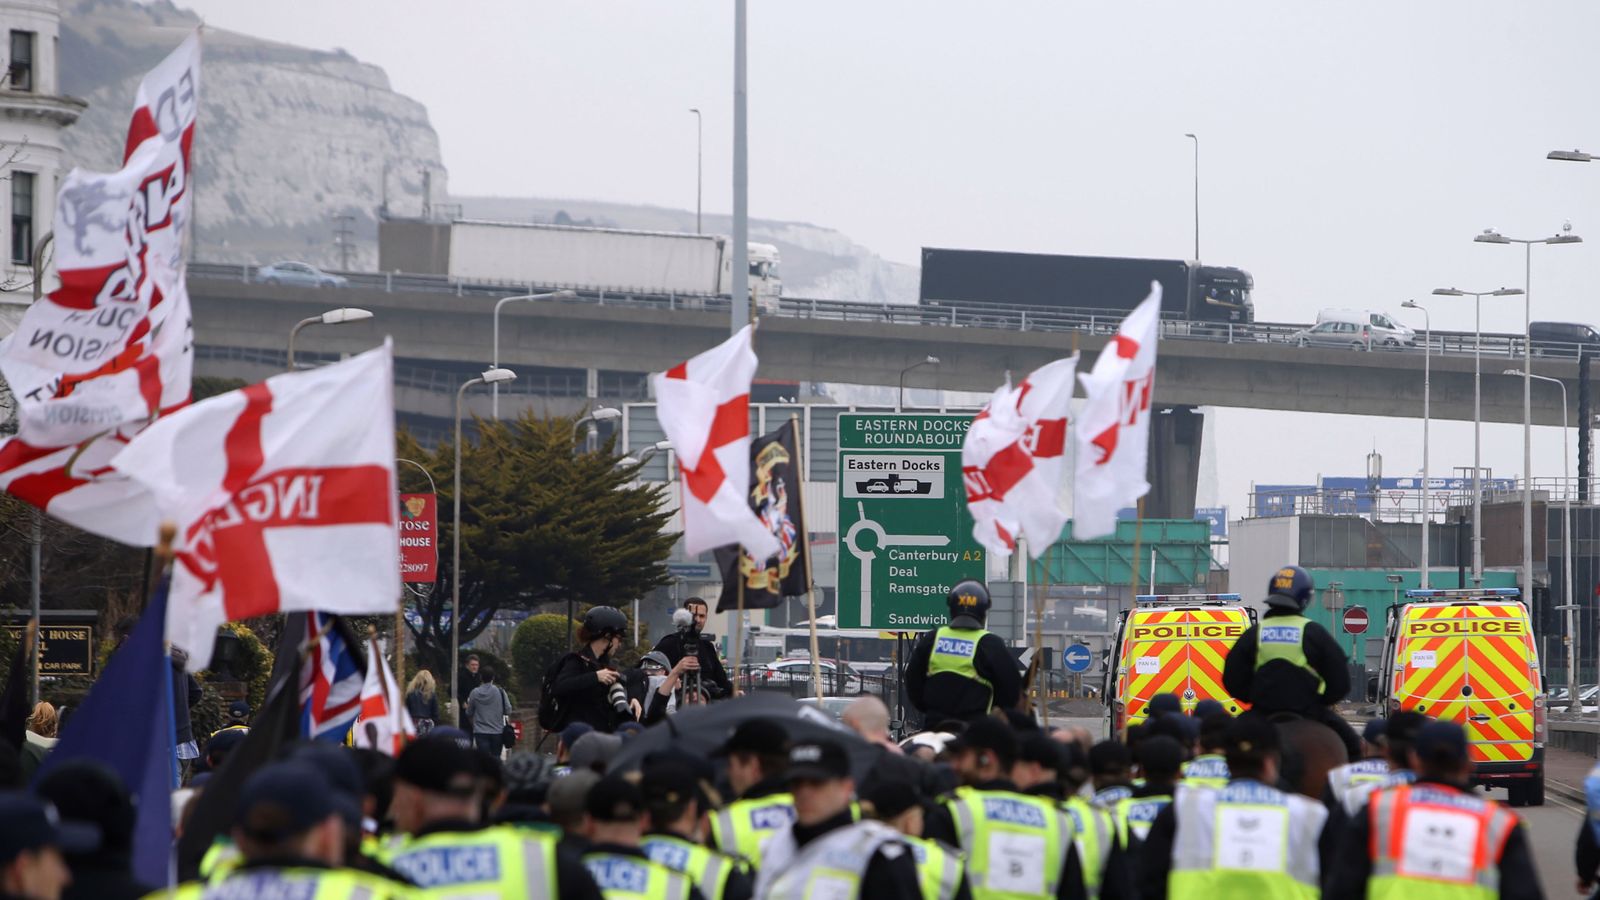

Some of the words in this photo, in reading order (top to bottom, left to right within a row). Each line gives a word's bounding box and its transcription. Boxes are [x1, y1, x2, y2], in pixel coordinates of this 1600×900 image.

[855, 419, 918, 431] EASTERN
[923, 420, 971, 432] DOCKS
[864, 433, 963, 445] ROUNDABOUT
[848, 459, 897, 471] Eastern
[902, 460, 940, 471] Docks
[399, 537, 431, 547] HOUSE
[888, 549, 959, 563] Canterbury
[889, 566, 918, 577] Deal
[889, 582, 951, 596] Ramsgate
[888, 613, 948, 624] Sandwich
[1134, 626, 1242, 638] POLICE
[1410, 621, 1521, 634] POLICE
[49, 630, 87, 640] HOUSE
[1262, 628, 1299, 641] POLICE
[937, 640, 974, 655] POLICE
[44, 662, 60, 670] CAR
[61, 662, 82, 670] PARK
